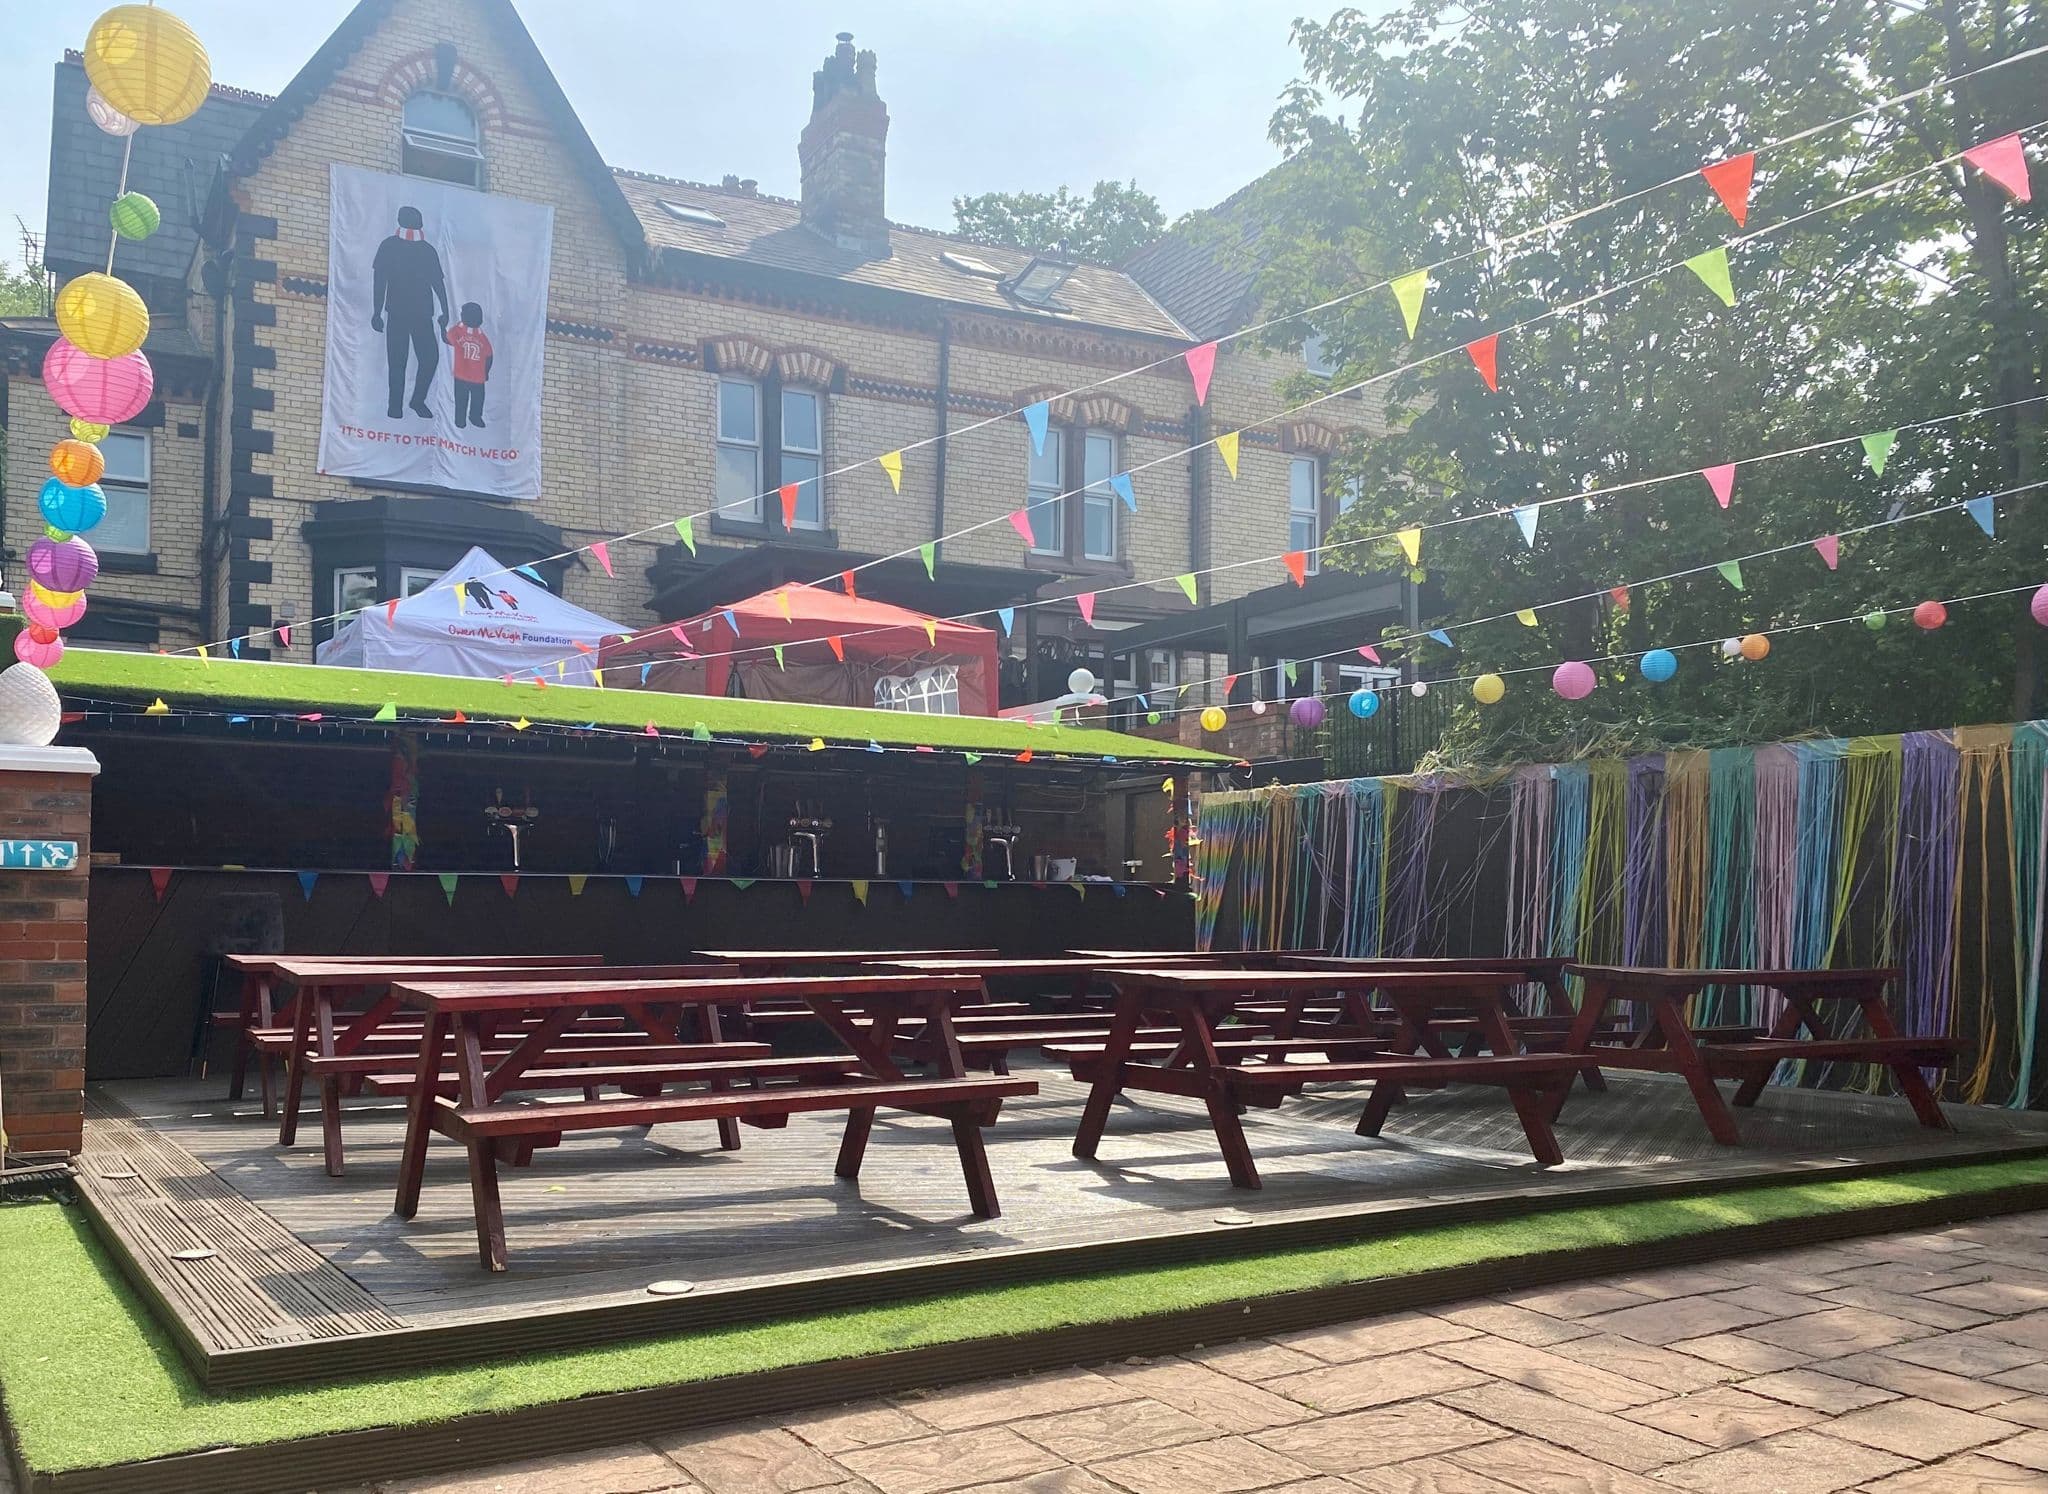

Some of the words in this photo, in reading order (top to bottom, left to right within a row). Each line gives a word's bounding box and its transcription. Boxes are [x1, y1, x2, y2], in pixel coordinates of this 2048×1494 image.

[464, 341, 480, 361] 12
[367, 431, 391, 442] OFF
[394, 434, 411, 445] TO
[414, 435, 436, 446] THE
[438, 438, 476, 456] MATCH
[480, 448, 498, 459] WE
[448, 624, 475, 636] Owen
[478, 627, 521, 644] McVeigh
[522, 633, 573, 646] Foundation
